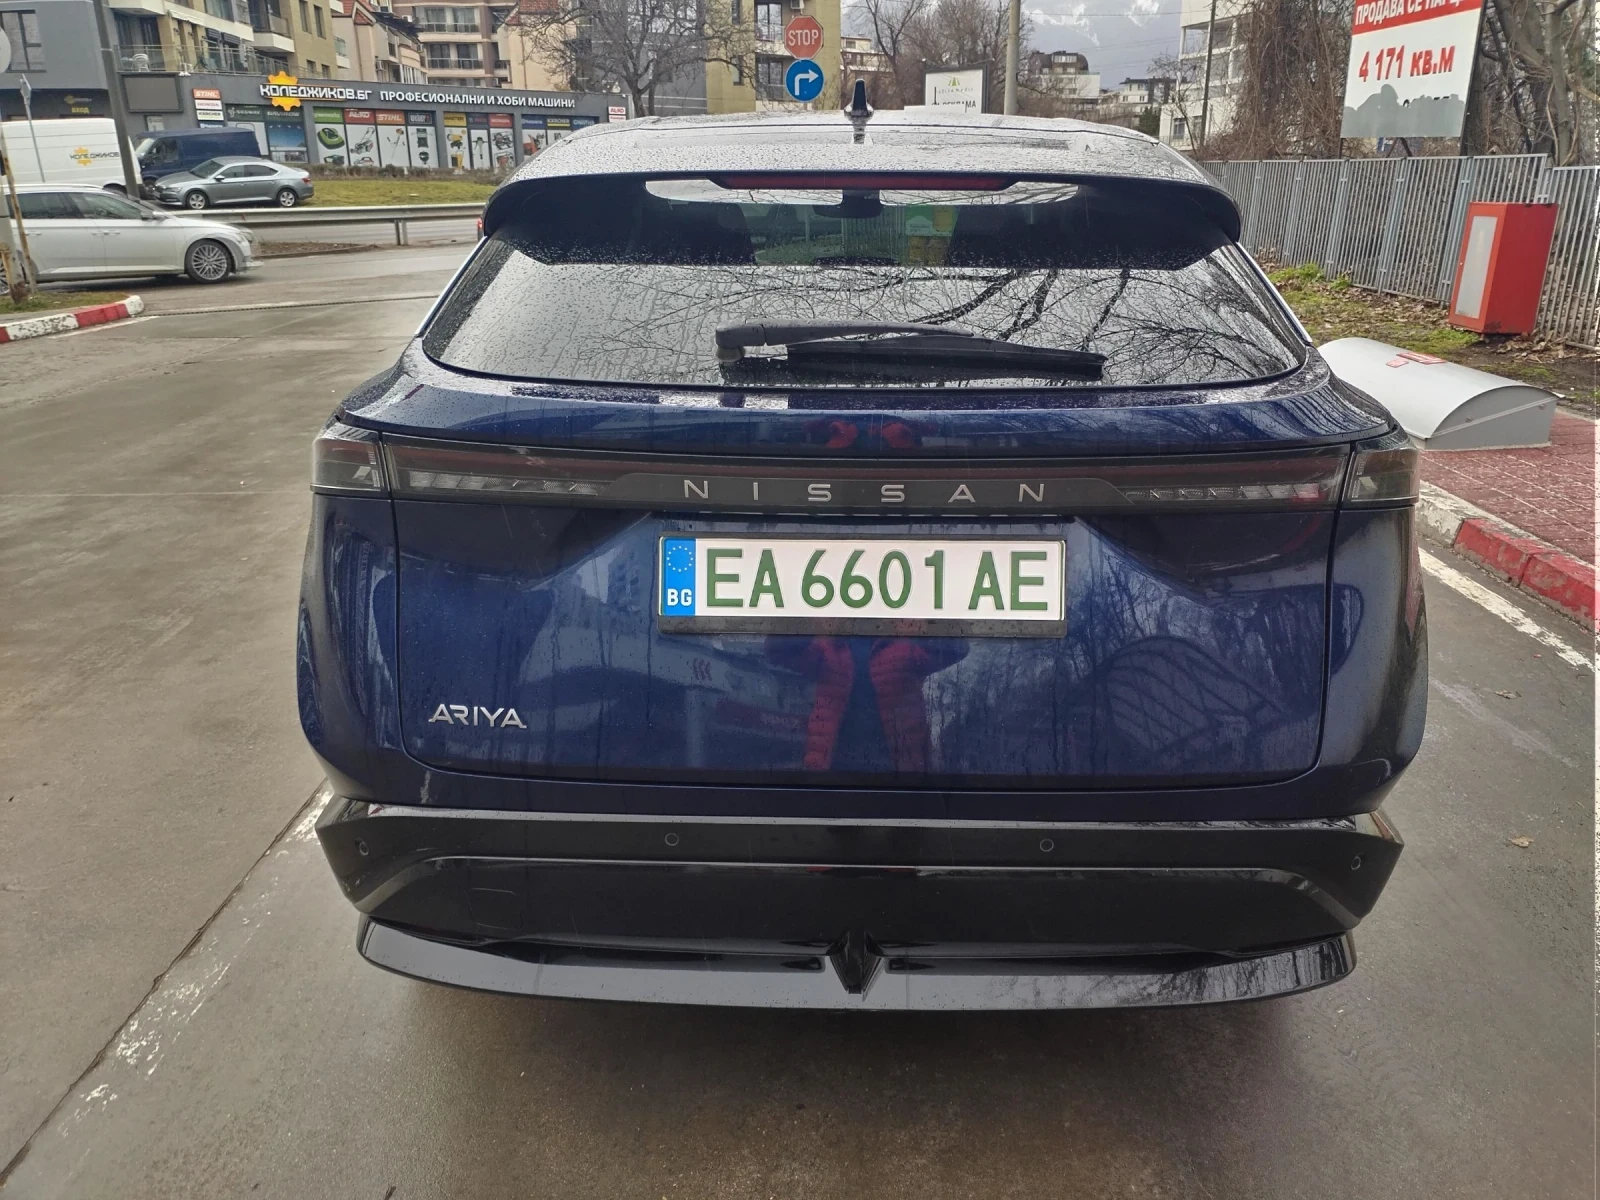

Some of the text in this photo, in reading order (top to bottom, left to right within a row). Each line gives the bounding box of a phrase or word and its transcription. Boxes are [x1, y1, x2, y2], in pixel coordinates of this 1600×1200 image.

[1355, 0, 1404, 25] ПРОДАВА
[788, 29, 819, 46] STOP
[1358, 51, 1370, 82] 4
[1375, 45, 1405, 80] 171
[380, 91, 576, 108] ПРОФЕСИОНАЛНИ И ХОБИ МАШИНИ
[683, 479, 1045, 503] NISSAN
[706, 548, 1048, 611] EA 6601 AE
[667, 588, 693, 606] BG
[428, 703, 528, 729] ARIYA
